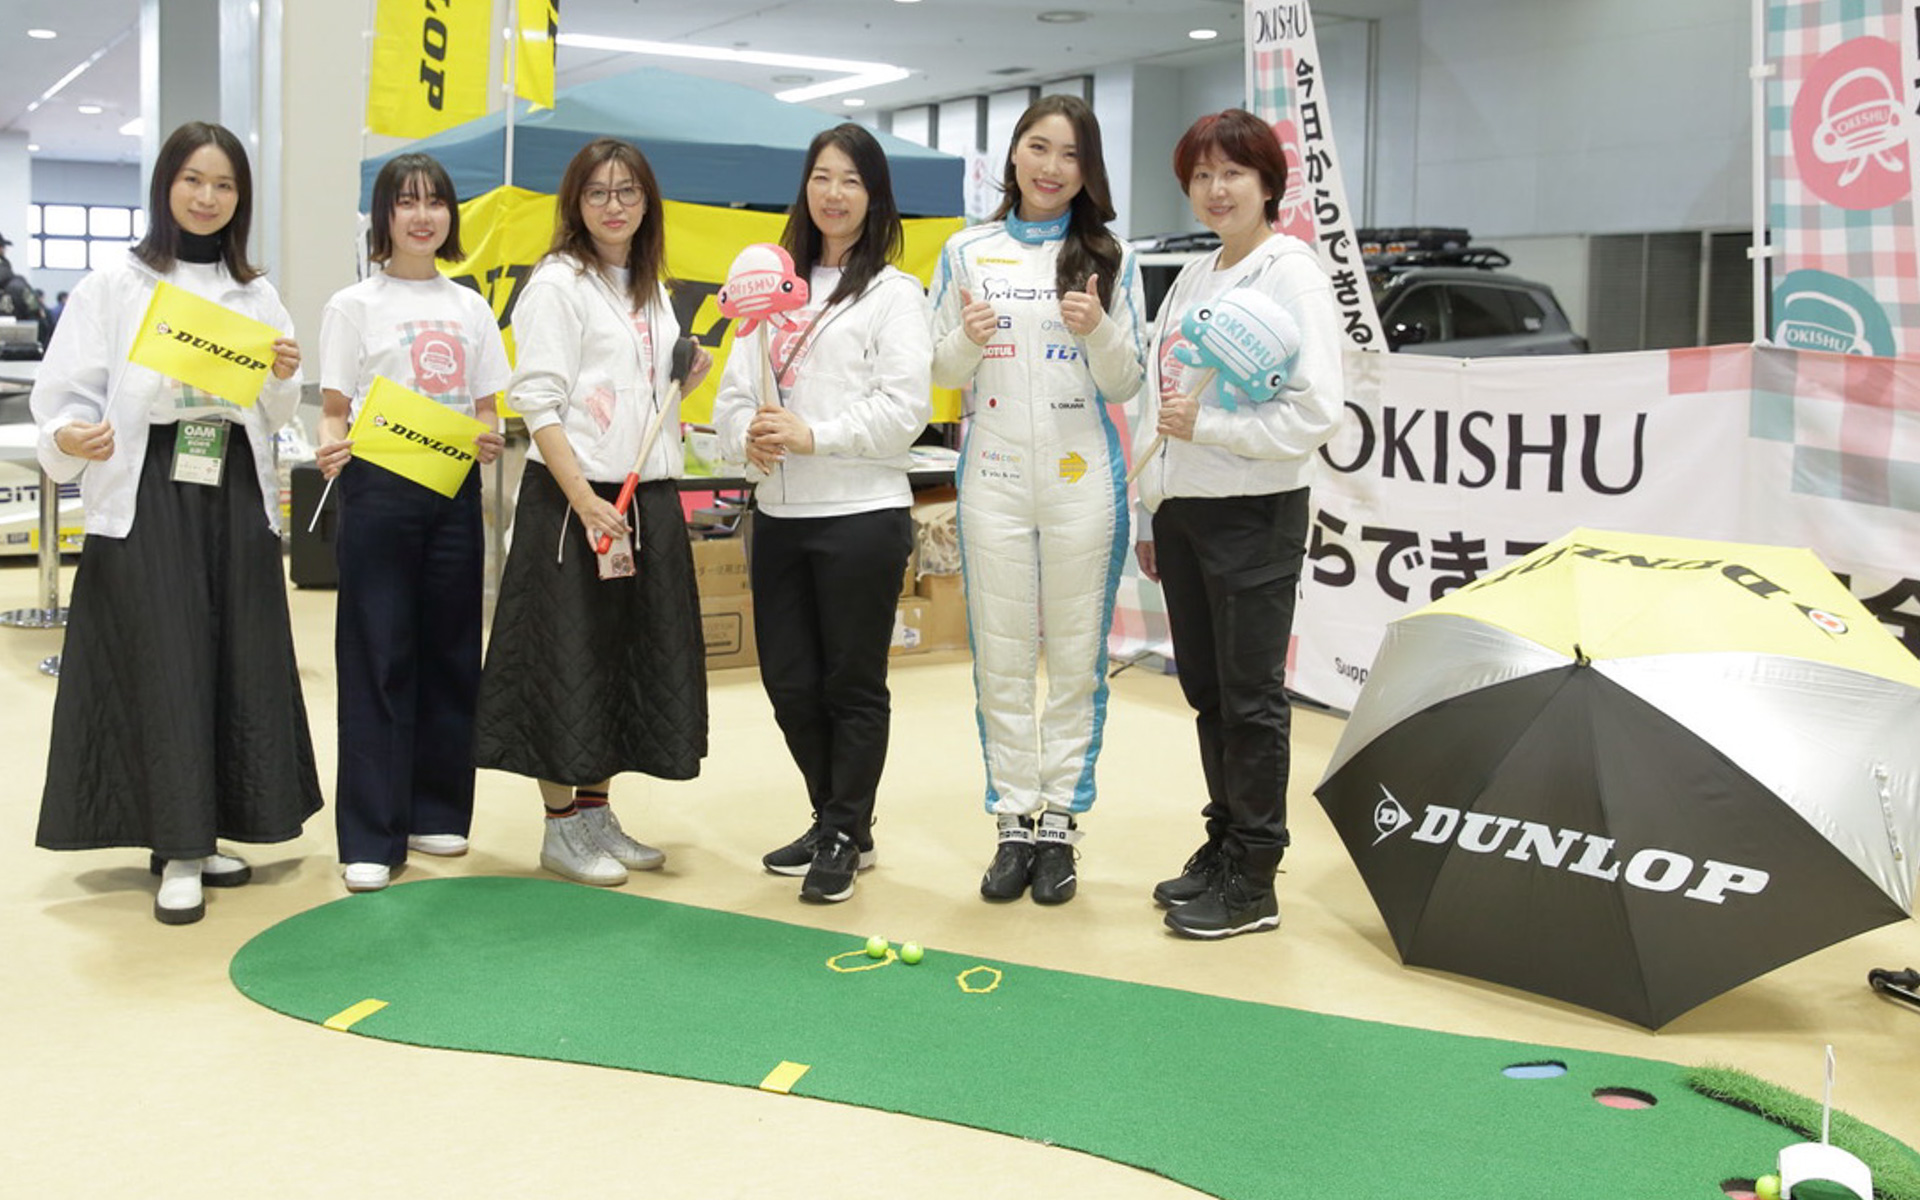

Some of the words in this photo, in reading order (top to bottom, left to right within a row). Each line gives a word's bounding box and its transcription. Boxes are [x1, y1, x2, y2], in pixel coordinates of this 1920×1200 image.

[1837, 108, 1890, 133] OKISHU
[1295, 58, 1380, 352] 今日からできる
[174, 330, 267, 371] DUNLOP
[1215, 311, 1278, 368] OKISHU
[1786, 328, 1848, 352] OKISHU
[184, 425, 216, 438] OAM
[389, 423, 473, 462] DUNLOP
[1318, 400, 1648, 495] OKISHU
[1410, 804, 1770, 904] DUNLOP
